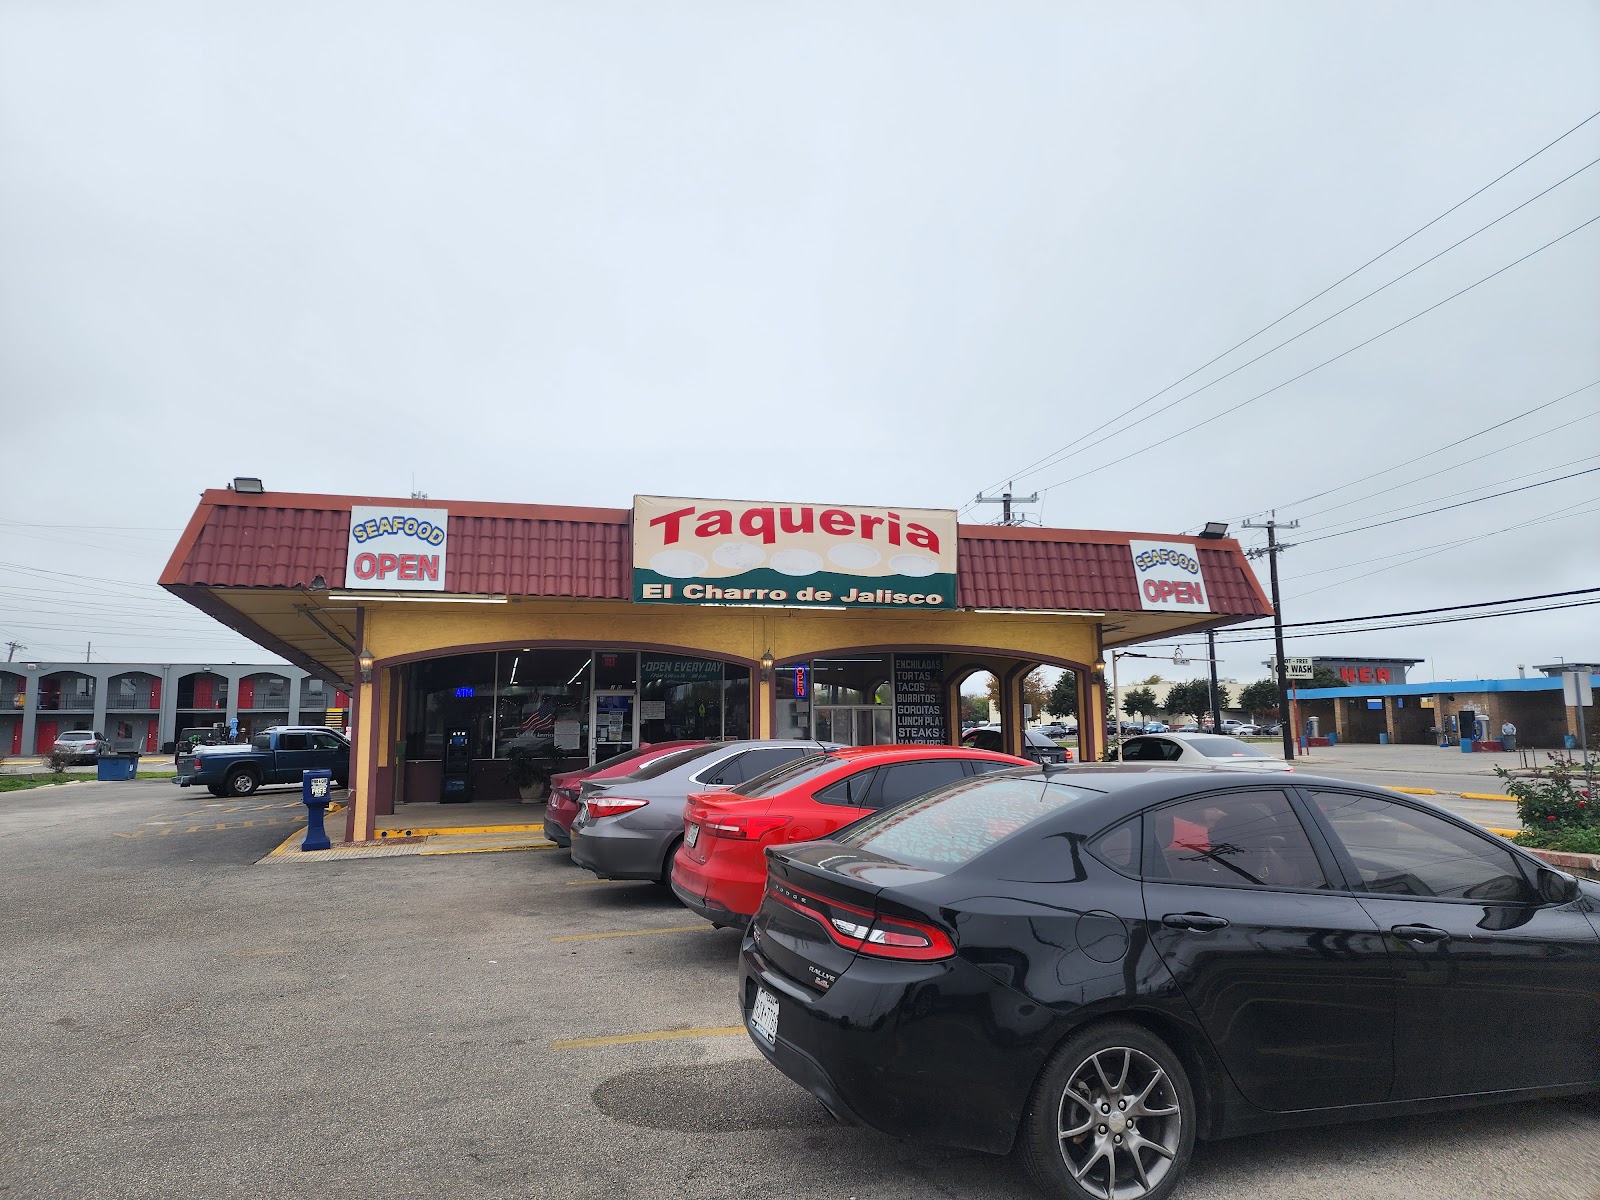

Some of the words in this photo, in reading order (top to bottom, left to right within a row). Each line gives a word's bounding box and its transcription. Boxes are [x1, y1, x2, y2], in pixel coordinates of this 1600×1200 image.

[353, 516, 445, 546] SEAFOOD
[650, 506, 940, 554] Taqueria
[354, 552, 440, 581] OPEN
[1135, 549, 1199, 575] SEAFOOD
[642, 583, 673, 599] El
[682, 584, 788, 600] Charro
[796, 586, 832, 602] de
[840, 588, 944, 605] Jalisco
[1143, 579, 1205, 604] OPEN
[645, 661, 672, 672] OPEN
[674, 661, 704, 672] EVERY
[704, 661, 723, 672] DAY
[896, 660, 940, 669] ENCHILADAS
[1275, 664, 1289, 673] CR
[1291, 664, 1312, 673] WASH
[897, 671, 931, 680] TORTAS
[796, 667, 805, 696] OPEN
[897, 682, 925, 691] TACOS
[455, 687, 474, 697] ATM
[897, 694, 936, 703] BURRITOS
[897, 705, 940, 714] GORDITAS
[898, 716, 923, 726] LUNCH
[898, 728, 939, 737] STEAKS
[809, 965, 836, 982] RALLYE
